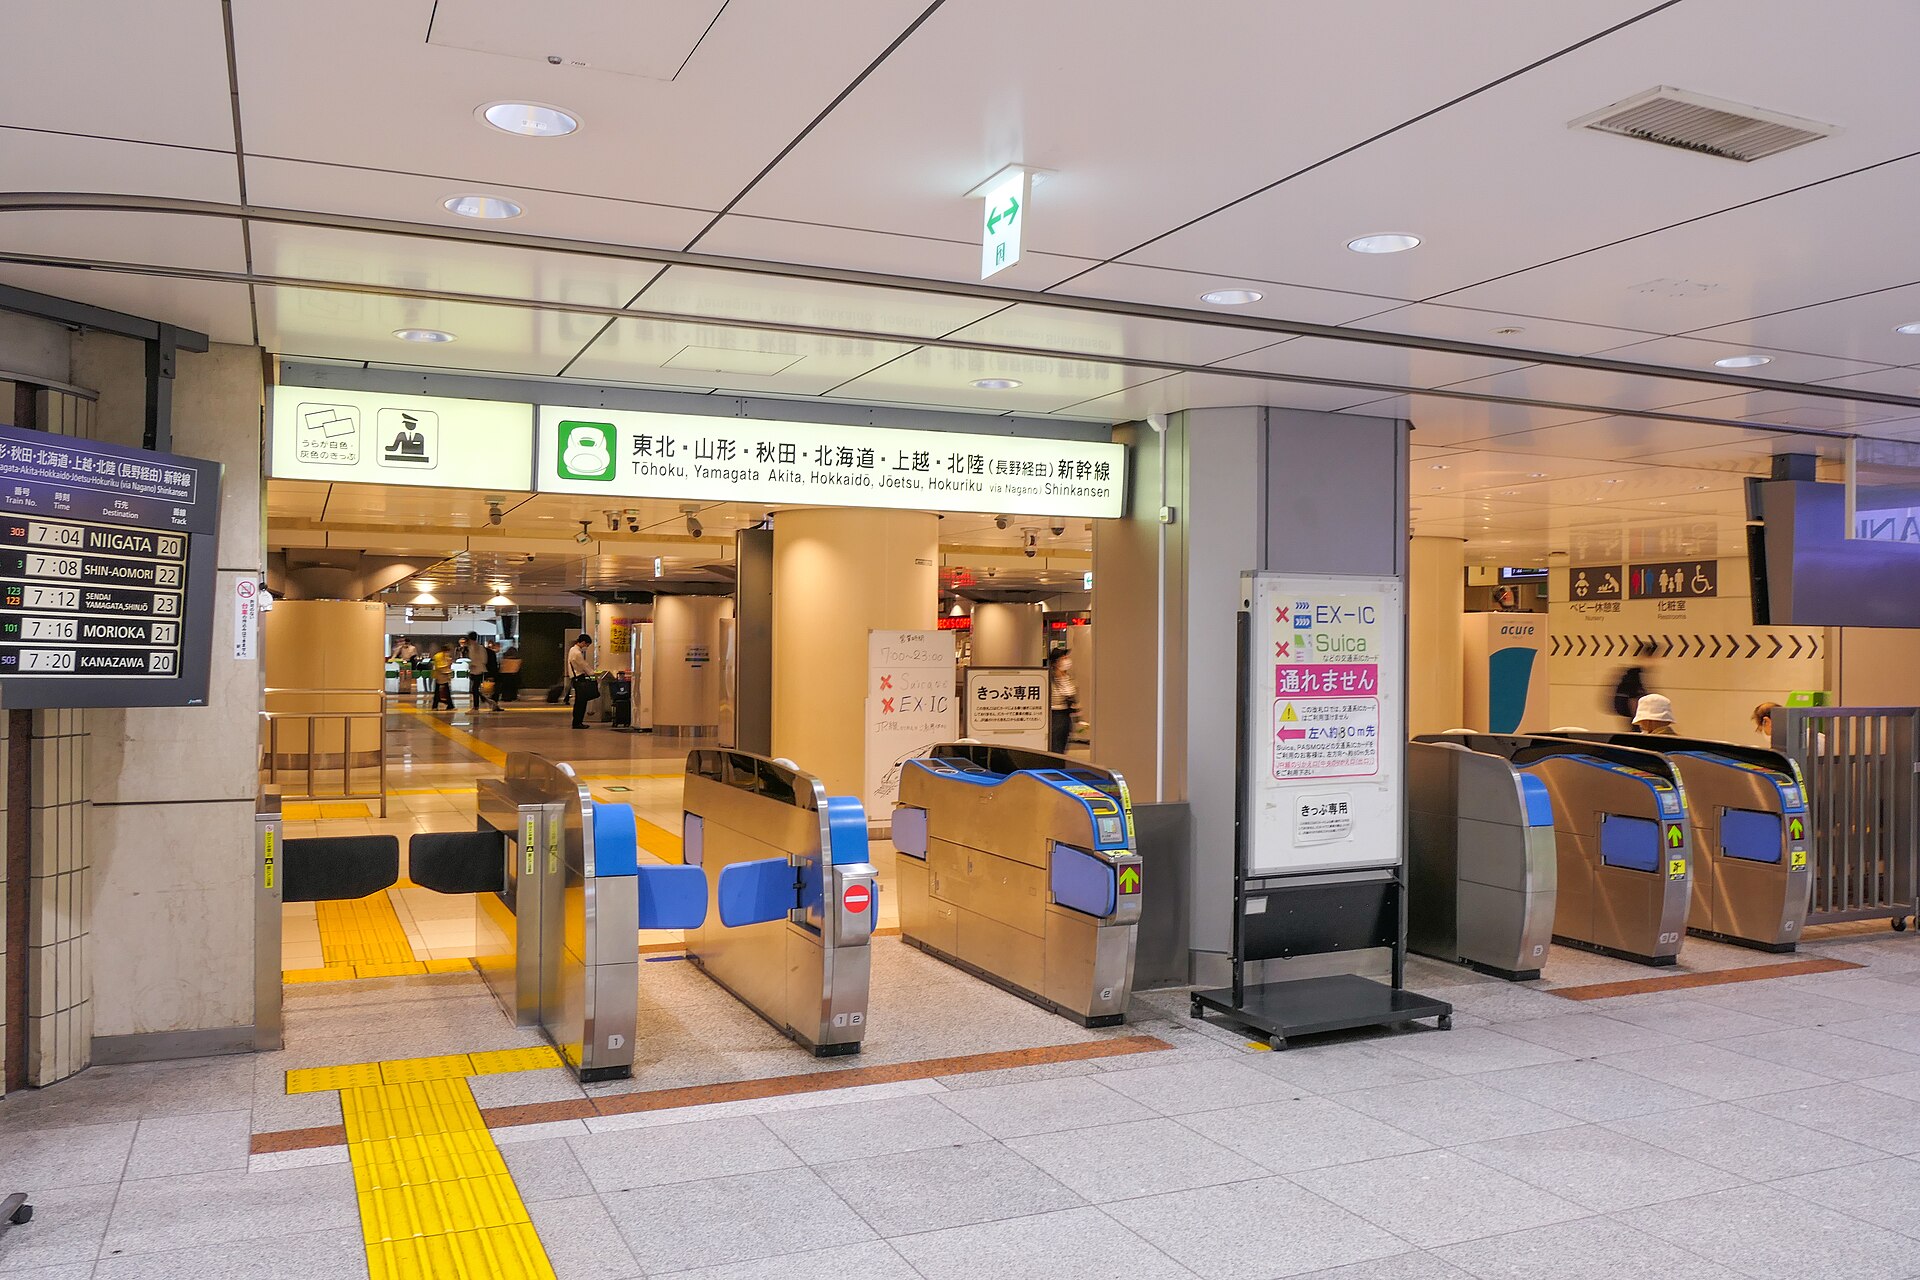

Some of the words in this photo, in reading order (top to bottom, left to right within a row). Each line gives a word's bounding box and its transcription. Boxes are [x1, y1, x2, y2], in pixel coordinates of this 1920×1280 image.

[632, 461, 688, 480] Tōhoku,
[768, 470, 805, 485] Akita,
[928, 478, 983, 492] Hokuriku
[1044, 483, 1110, 498] Shinkansen
[157, 484, 188, 498] Shinkansen
[6, 496, 23, 505] Train
[24, 498, 38, 507] No.
[54, 502, 70, 510] Time
[102, 508, 139, 520] Destination
[172, 516, 187, 525] Track
[114, 500, 129, 510] 行先
[90, 532, 152, 552] NIIGATA
[161, 540, 178, 554] 20
[84, 564, 154, 580] SHIN-AOMORI
[160, 568, 176, 583] 22
[6, 587, 21, 595] 123
[86, 592, 112, 600] SENDAI
[157, 598, 173, 612] 23
[1657, 601, 1686, 612] 化粧室
[1316, 606, 1375, 624] EX-IC
[4, 624, 18, 632] 101
[83, 625, 145, 639] MORIOKA
[155, 628, 171, 642] 21
[1501, 624, 1534, 635] acure
[1316, 634, 1366, 652] Suica
[80, 656, 145, 668] KANAZAWA
[153, 656, 170, 670] 20
[1280, 669, 1374, 692] 通れません
[978, 686, 1040, 700] きっぷ専用
[1301, 802, 1348, 816] きっぷ専用
